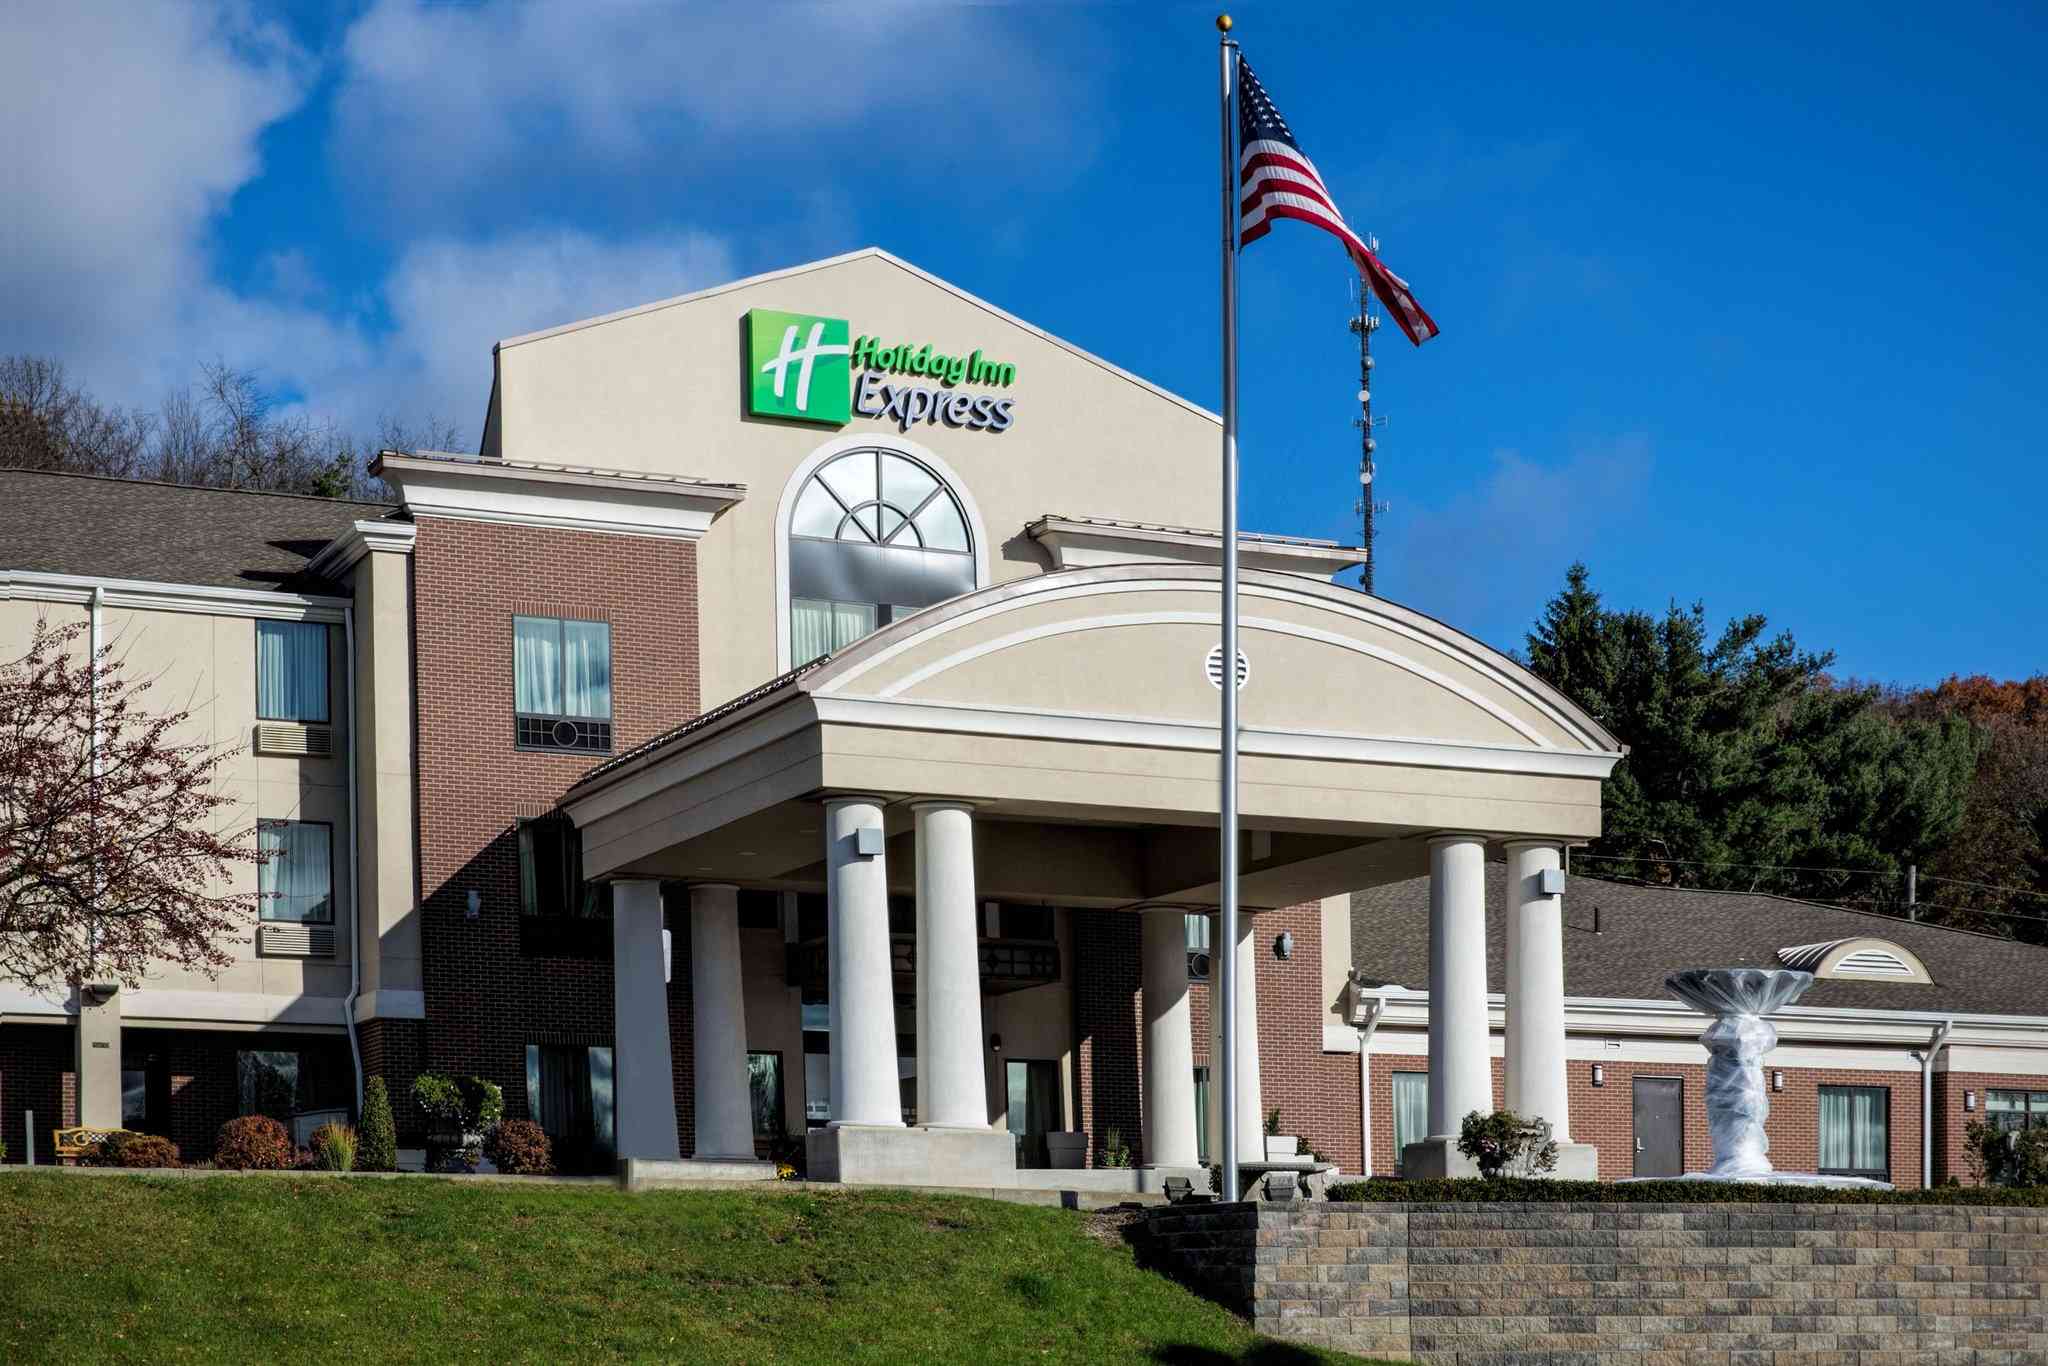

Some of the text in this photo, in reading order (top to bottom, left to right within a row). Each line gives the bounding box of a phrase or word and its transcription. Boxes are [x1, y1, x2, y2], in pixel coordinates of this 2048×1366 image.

[853, 335, 1016, 387] Holiday Inn
[854, 370, 1016, 432] Express
